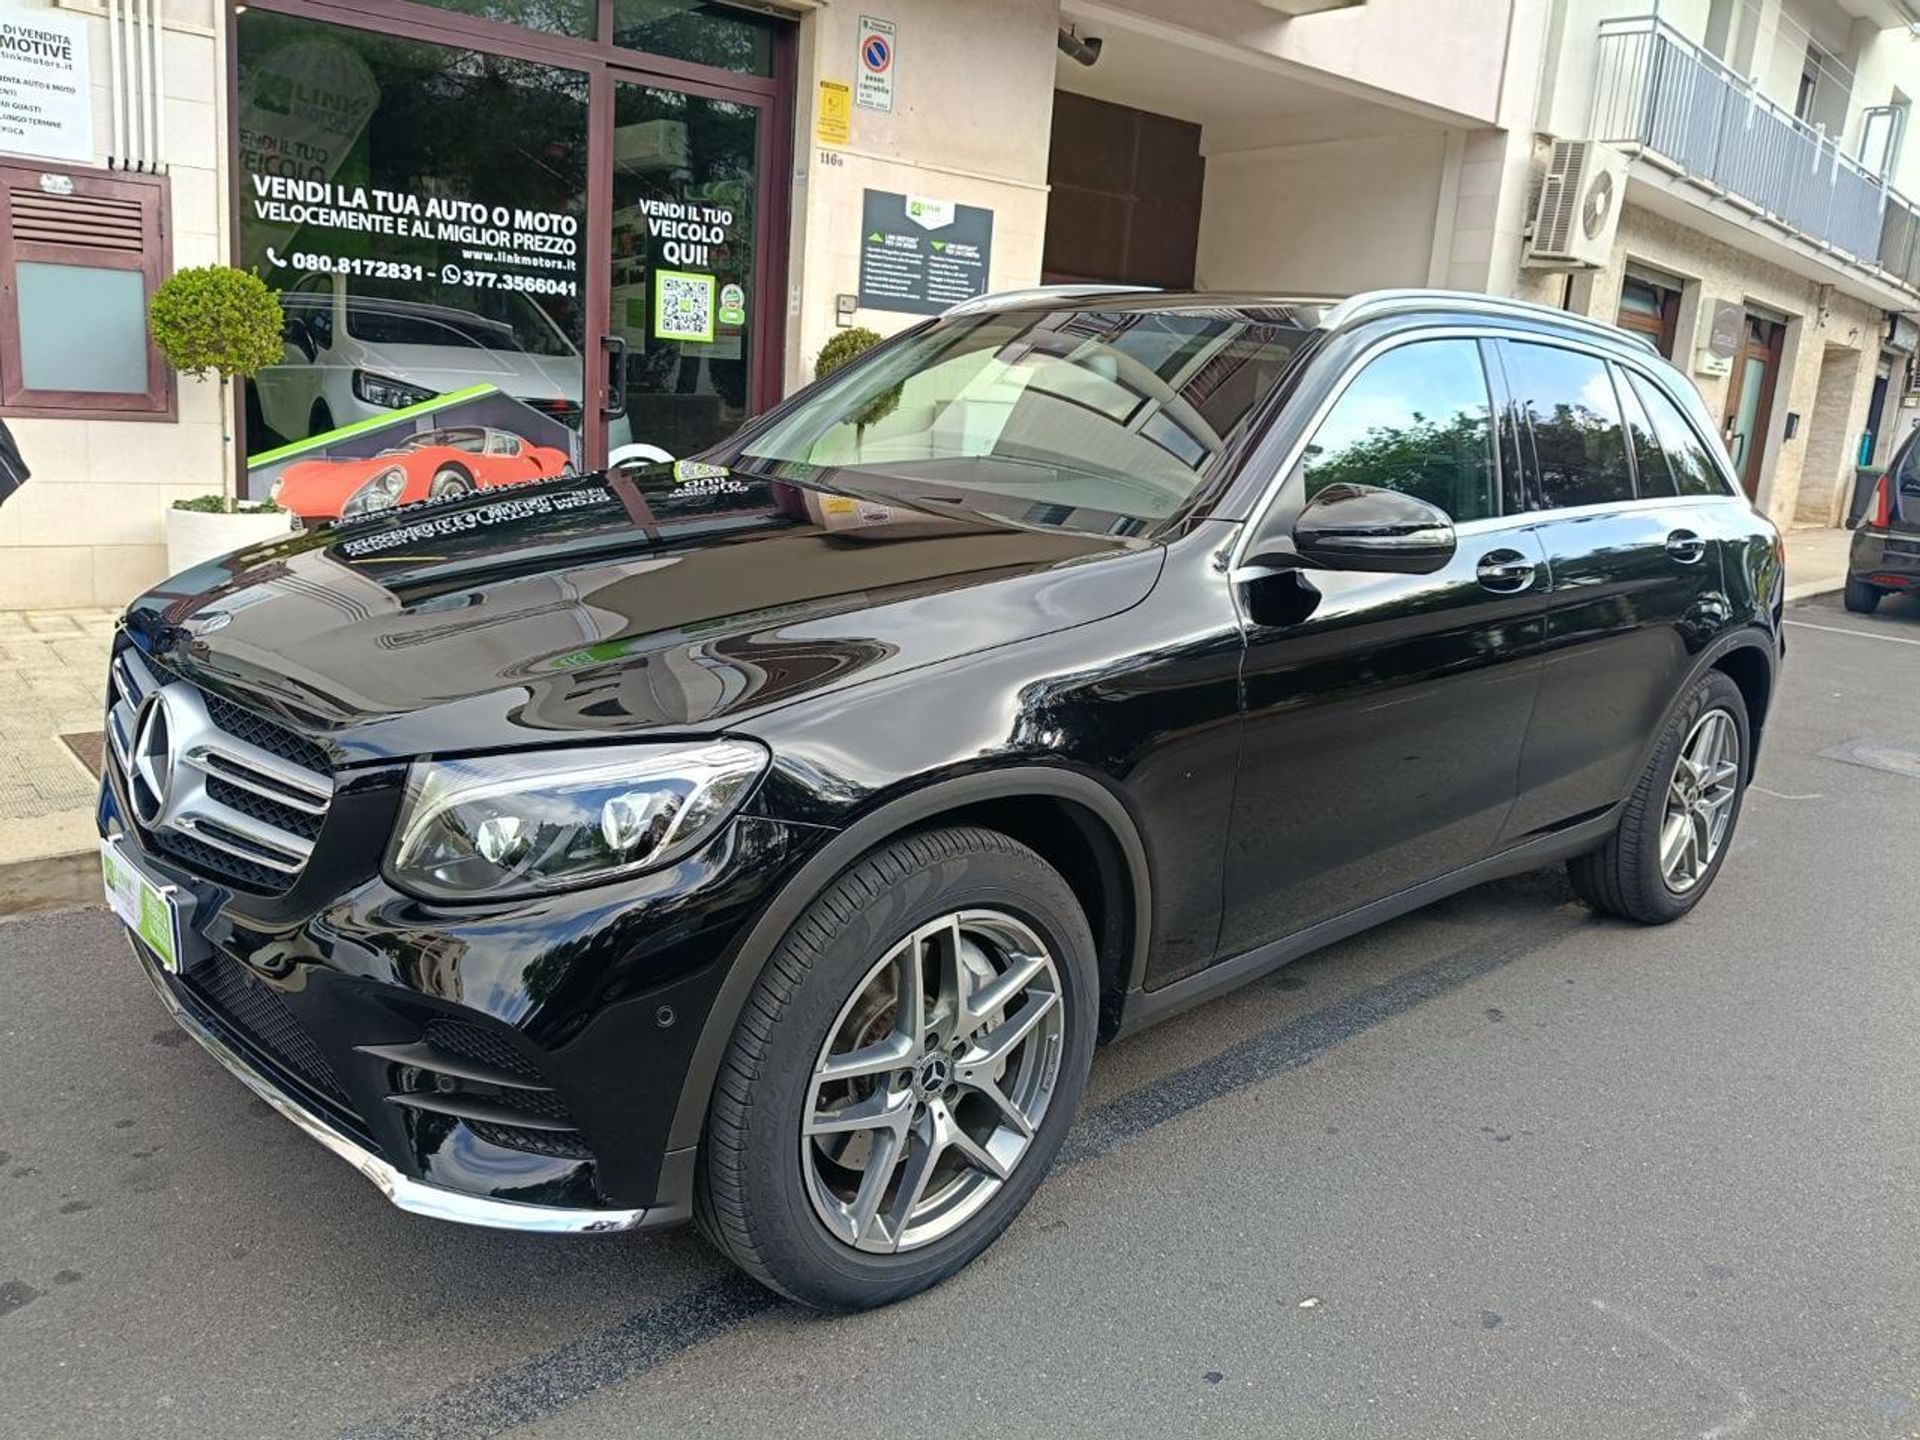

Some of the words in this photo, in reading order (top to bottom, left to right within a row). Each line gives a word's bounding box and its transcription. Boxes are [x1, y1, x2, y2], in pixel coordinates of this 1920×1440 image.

[3, 24, 16, 35] DI
[18, 26, 71, 46] VENDITA
[23, 78, 45, 90] AUTO
[12, 102, 41, 113] GUASTI
[29, 118, 62, 129] TERMINE
[295, 142, 328, 164] TUO
[252, 173, 331, 205] VENDI
[337, 185, 369, 210] LA
[372, 189, 421, 216] TUA
[425, 198, 488, 225] AUTO
[492, 206, 509, 227] O
[514, 209, 577, 236] MOTO
[639, 198, 685, 220] VENDI
[688, 206, 701, 222] IL
[702, 208, 733, 226] TUO
[254, 200, 394, 234] VELOCEMENTE
[397, 217, 408, 236] E
[411, 219, 435, 239] AL
[438, 222, 511, 248] MIGLIOR
[513, 232, 576, 256] PREZZO
[648, 217, 724, 245] VEICOLO
[462, 249, 577, 271] www.linkmotors.it
[663, 241, 708, 266] QUI!
[292, 252, 422, 282] 080.8172831
[463, 270, 577, 297] 377.3566041
